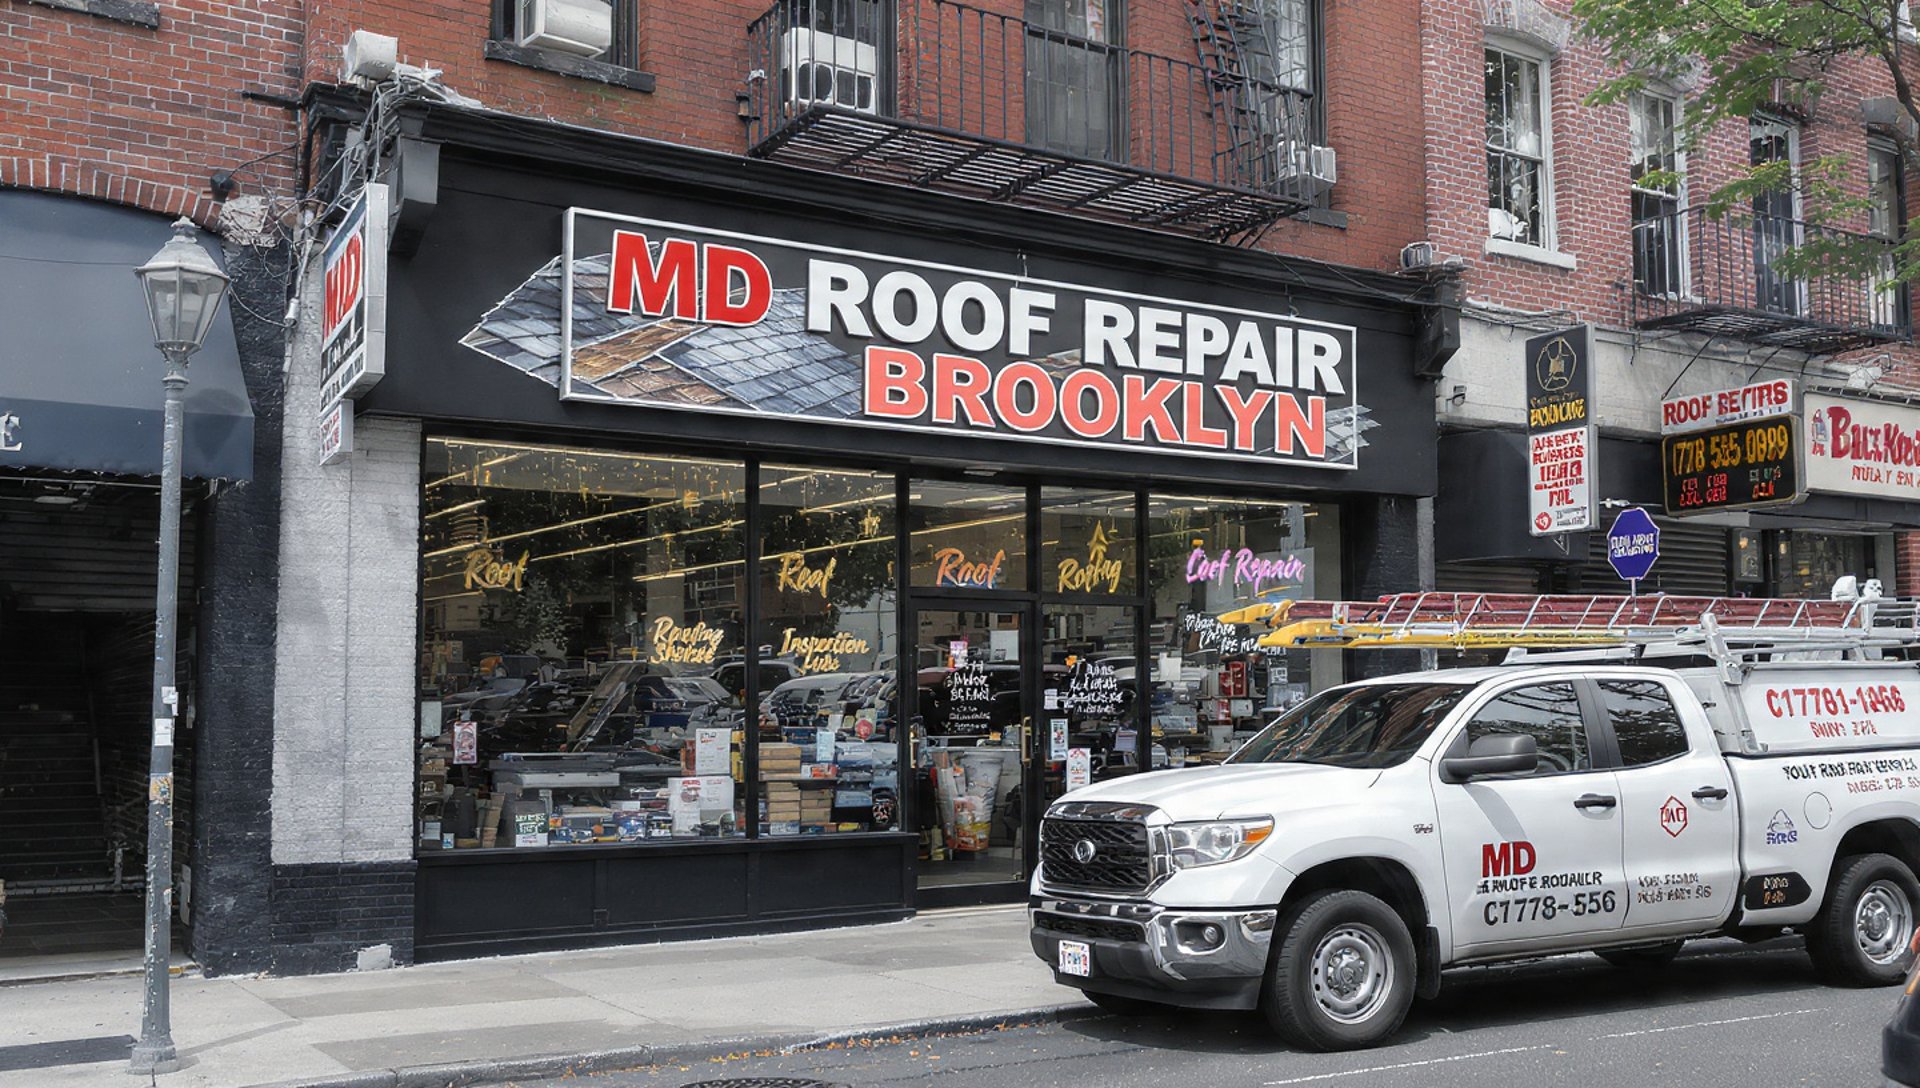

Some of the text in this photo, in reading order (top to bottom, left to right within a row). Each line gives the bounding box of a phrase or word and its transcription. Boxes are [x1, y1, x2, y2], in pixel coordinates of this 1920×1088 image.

[607, 229, 1346, 395] MD ROOF REPAIR
[863, 345, 1326, 458] BROOKLYN
[1663, 394, 1712, 426] ROOF
[1482, 841, 1536, 878] MD
